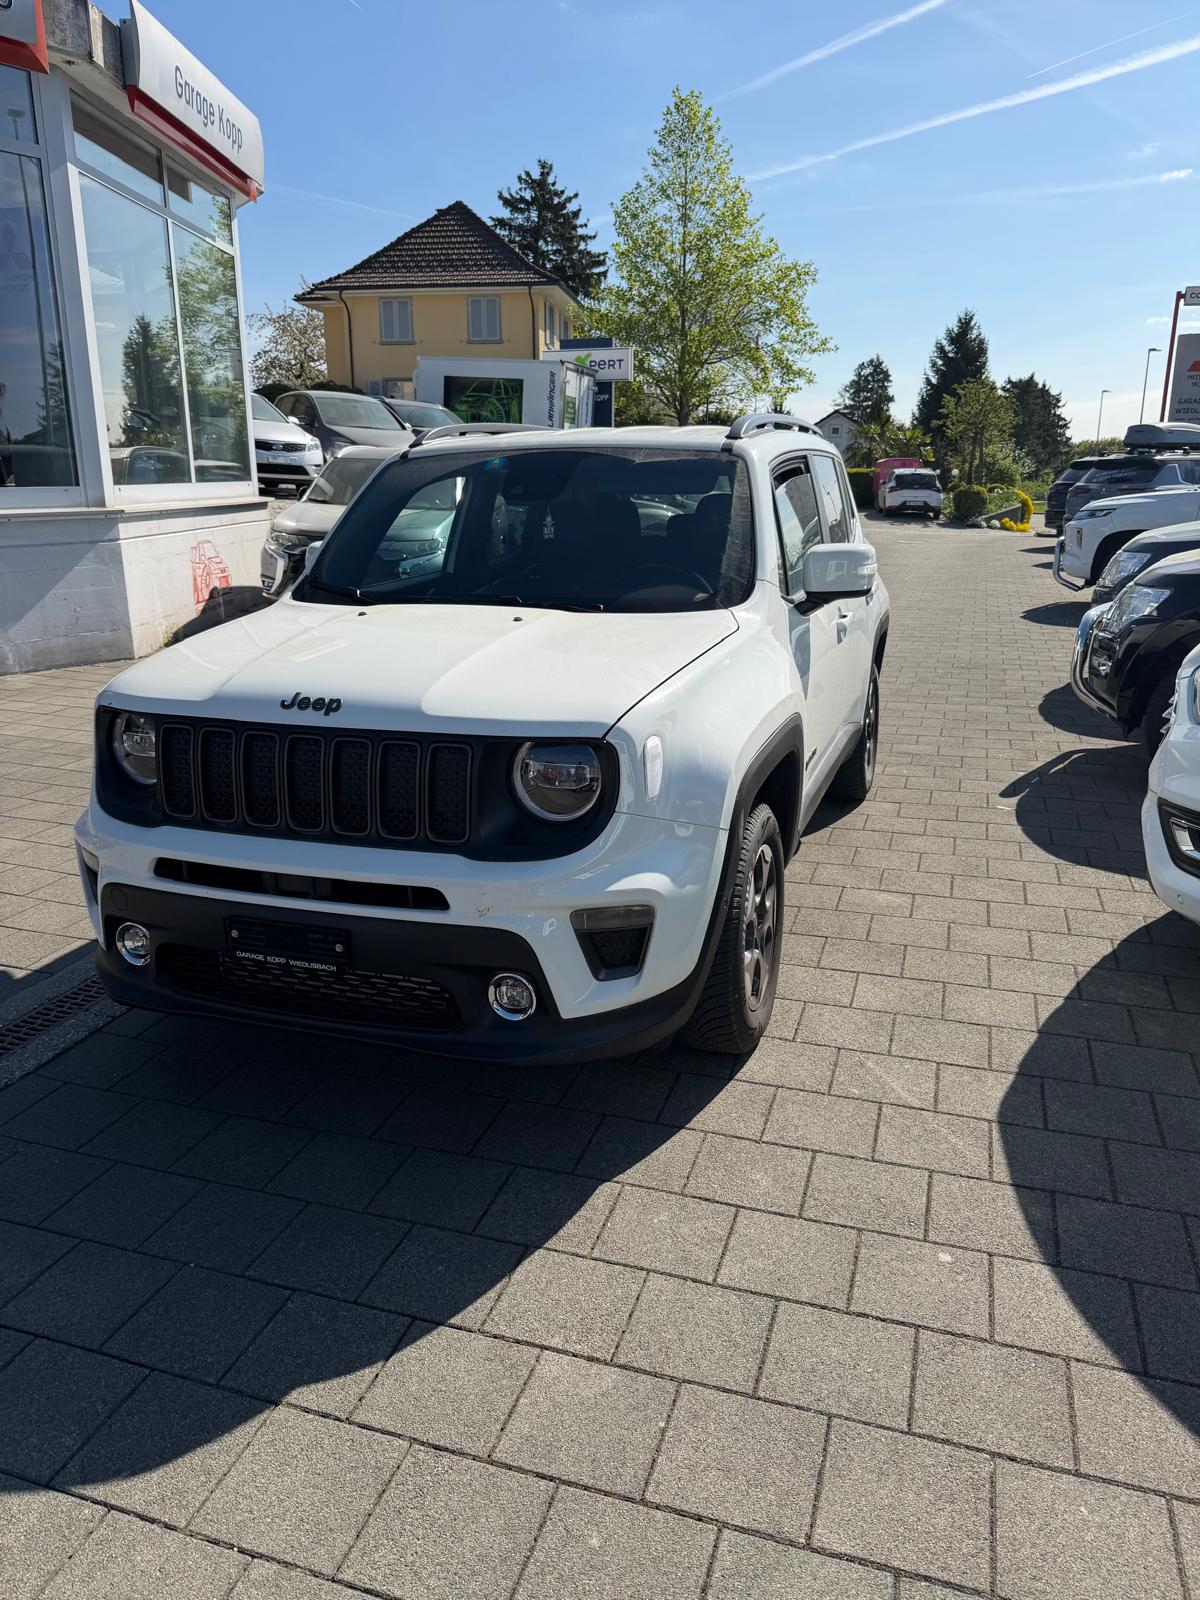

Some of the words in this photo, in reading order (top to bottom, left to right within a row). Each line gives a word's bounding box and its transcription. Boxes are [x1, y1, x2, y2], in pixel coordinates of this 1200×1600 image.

[174, 65, 215, 128] Garage
[218, 104, 243, 154] Kopp
[280, 692, 342, 716] Jeep
[236, 950, 265, 962] GARAGE
[266, 955, 287, 964] KOPP
[288, 959, 337, 972] WIEDLISBACH
